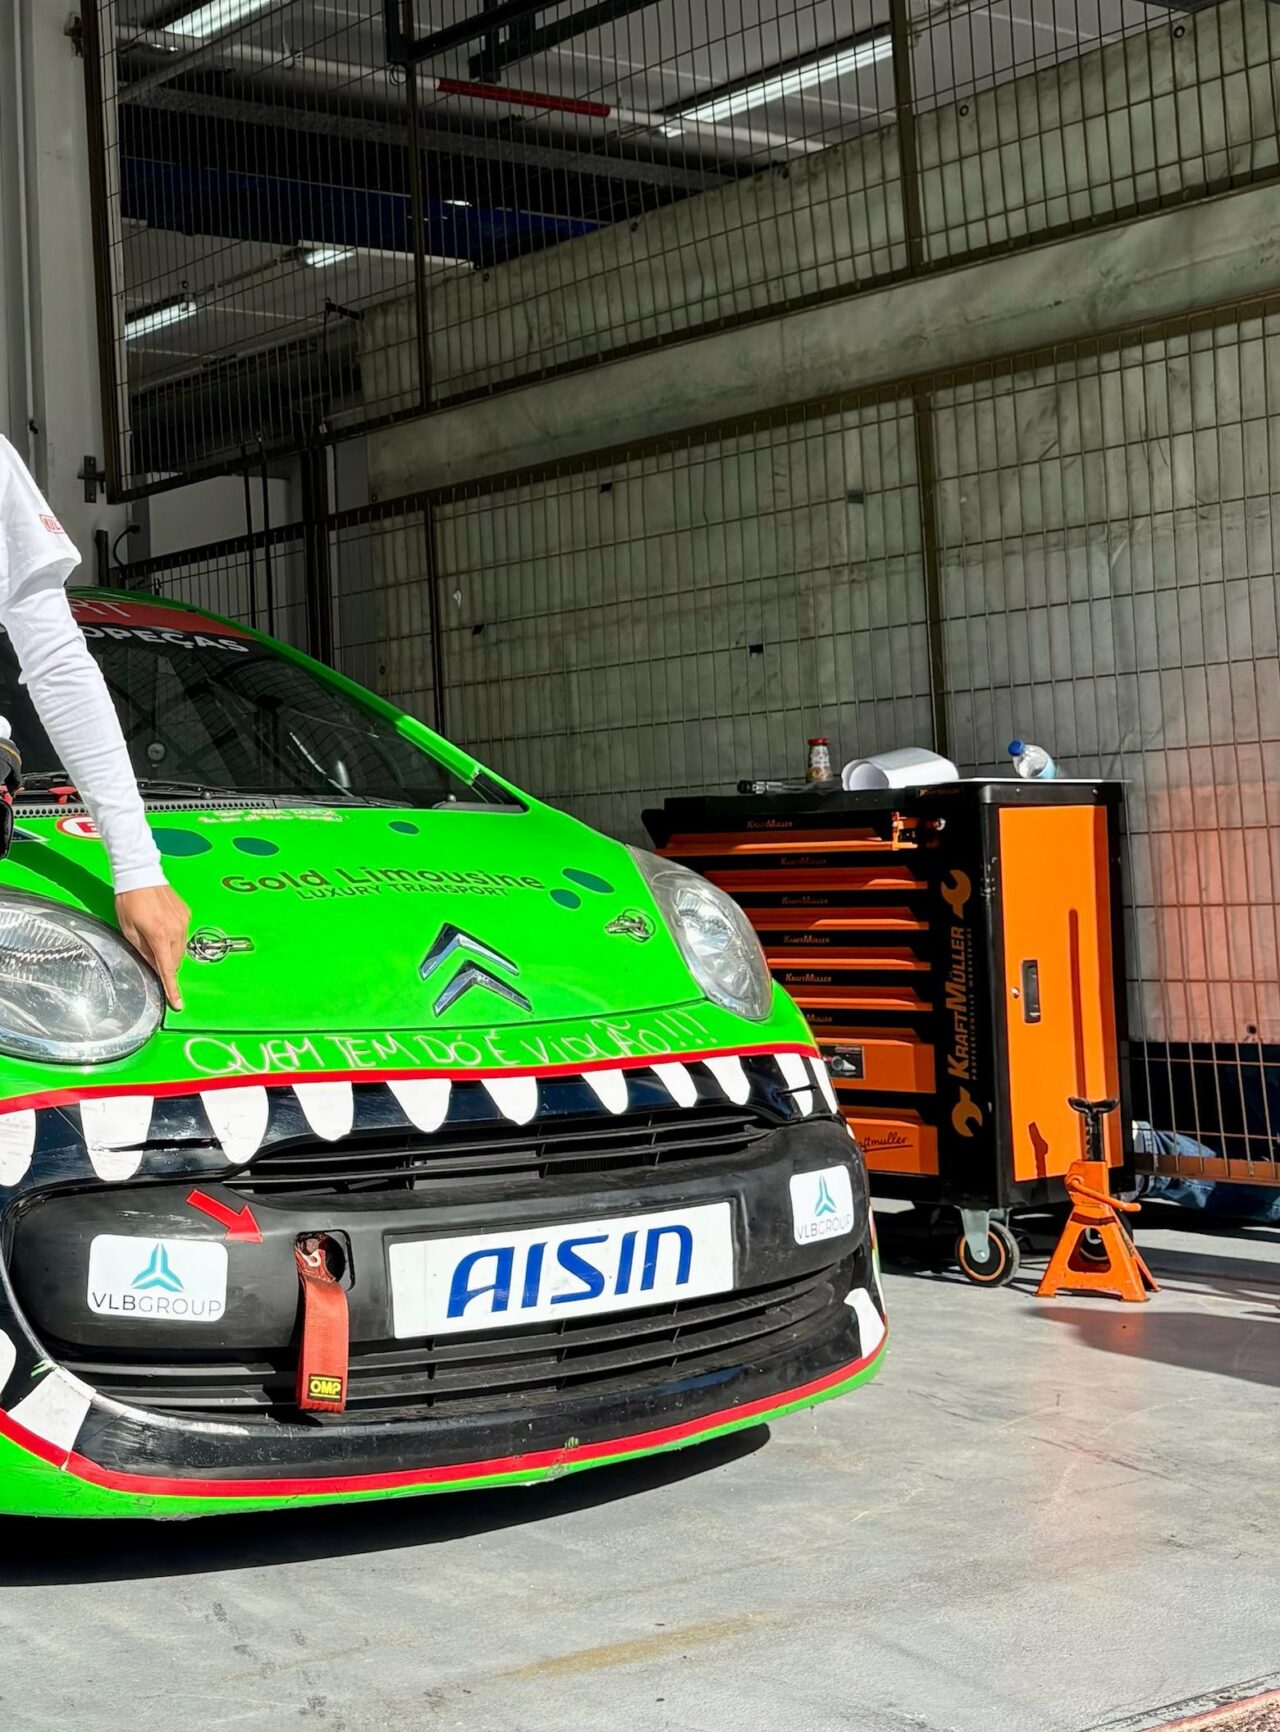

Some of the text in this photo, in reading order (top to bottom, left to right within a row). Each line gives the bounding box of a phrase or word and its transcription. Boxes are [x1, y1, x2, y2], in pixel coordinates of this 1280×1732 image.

[78, 625, 249, 652] OPEÇAS
[221, 865, 546, 893] Gold Limousine
[296, 882, 512, 900] LUXURY TRANSPORT
[185, 1036, 325, 1074] QUEM
[324, 1033, 420, 1068] TEM
[446, 1224, 693, 1319] AISIN
[92, 1291, 222, 1317] VLBGROUP
[310, 1380, 341, 1395] OMP
